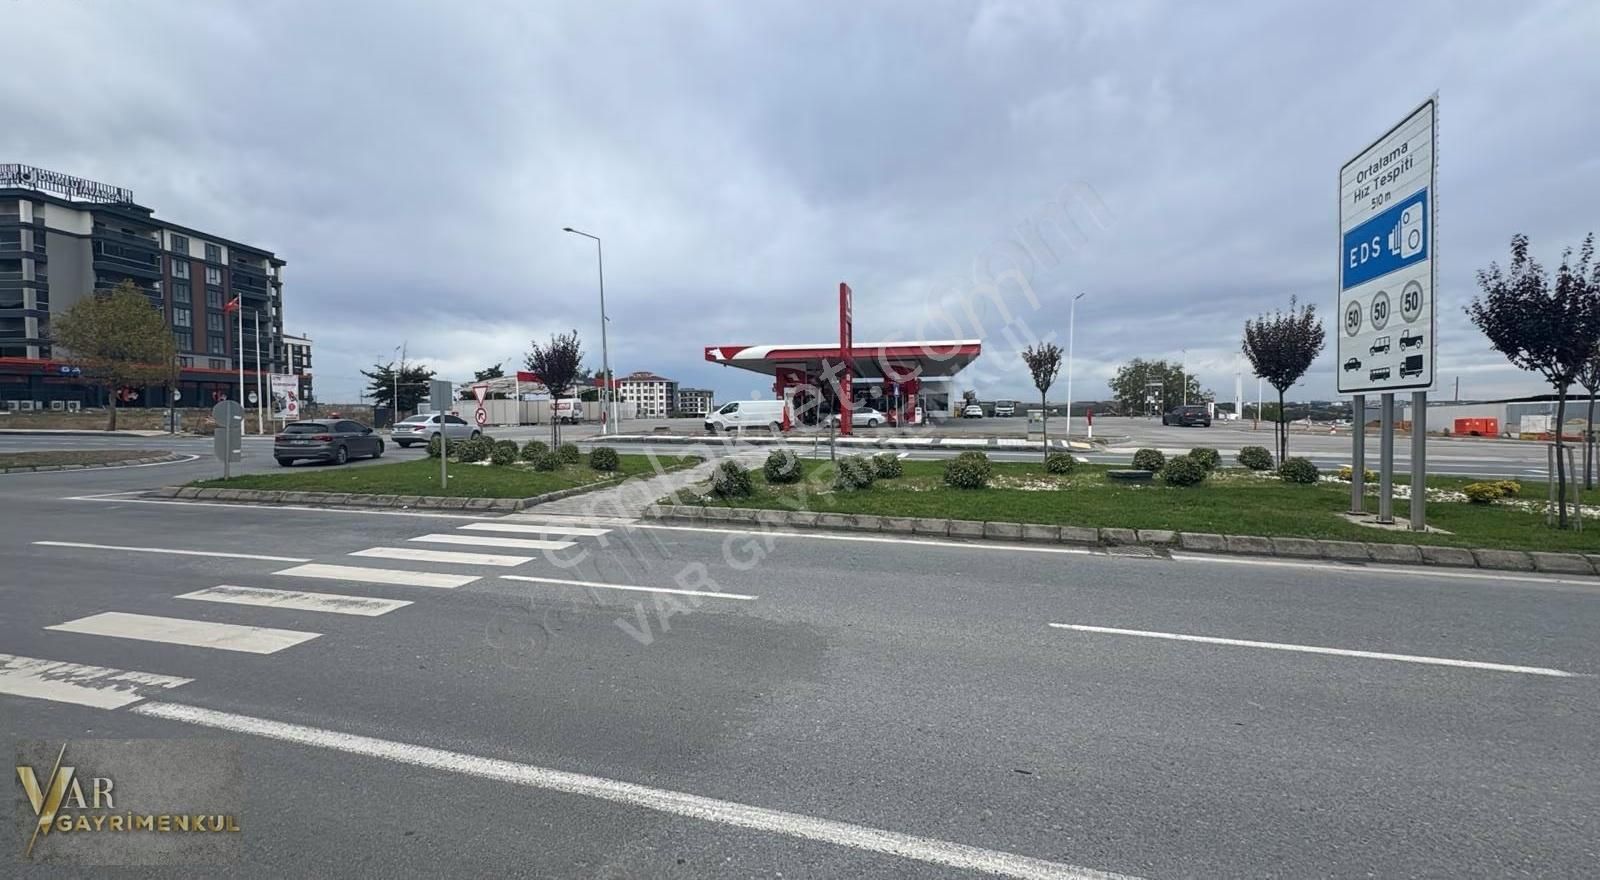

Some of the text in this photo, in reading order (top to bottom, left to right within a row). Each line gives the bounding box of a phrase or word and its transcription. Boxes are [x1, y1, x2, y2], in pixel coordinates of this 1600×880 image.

[1356, 142, 1408, 184] Ortalama
[1374, 154, 1414, 190] Tespiti
[1371, 191, 1391, 210] 510 m
[1350, 236, 1381, 268] EDS
[1348, 291, 1418, 328] 50 50 50
